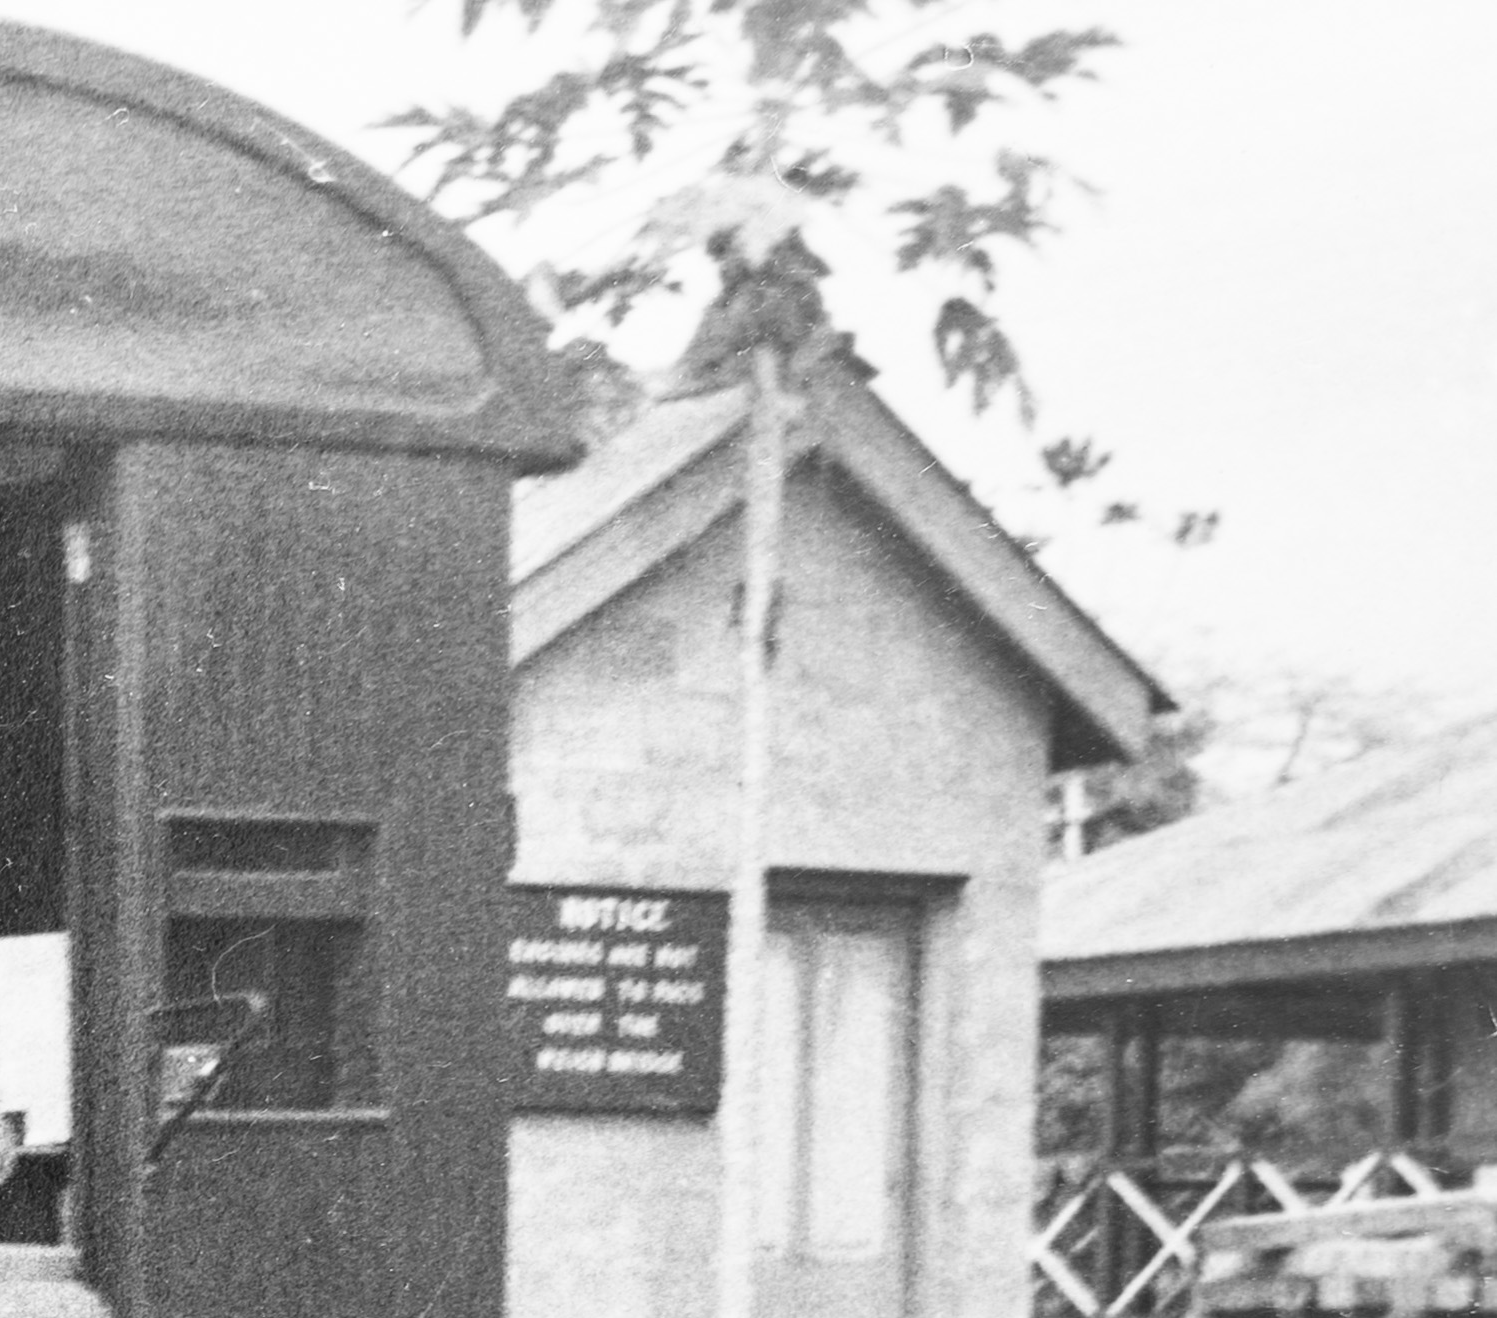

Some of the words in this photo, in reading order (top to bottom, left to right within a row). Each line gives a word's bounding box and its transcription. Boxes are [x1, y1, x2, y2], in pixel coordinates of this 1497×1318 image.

[559, 896, 672, 932] NOTICE
[607, 943, 648, 967] ARE
[654, 945, 699, 969] NOT
[617, 979, 649, 1003] TO
[617, 1014, 659, 1038] THE
